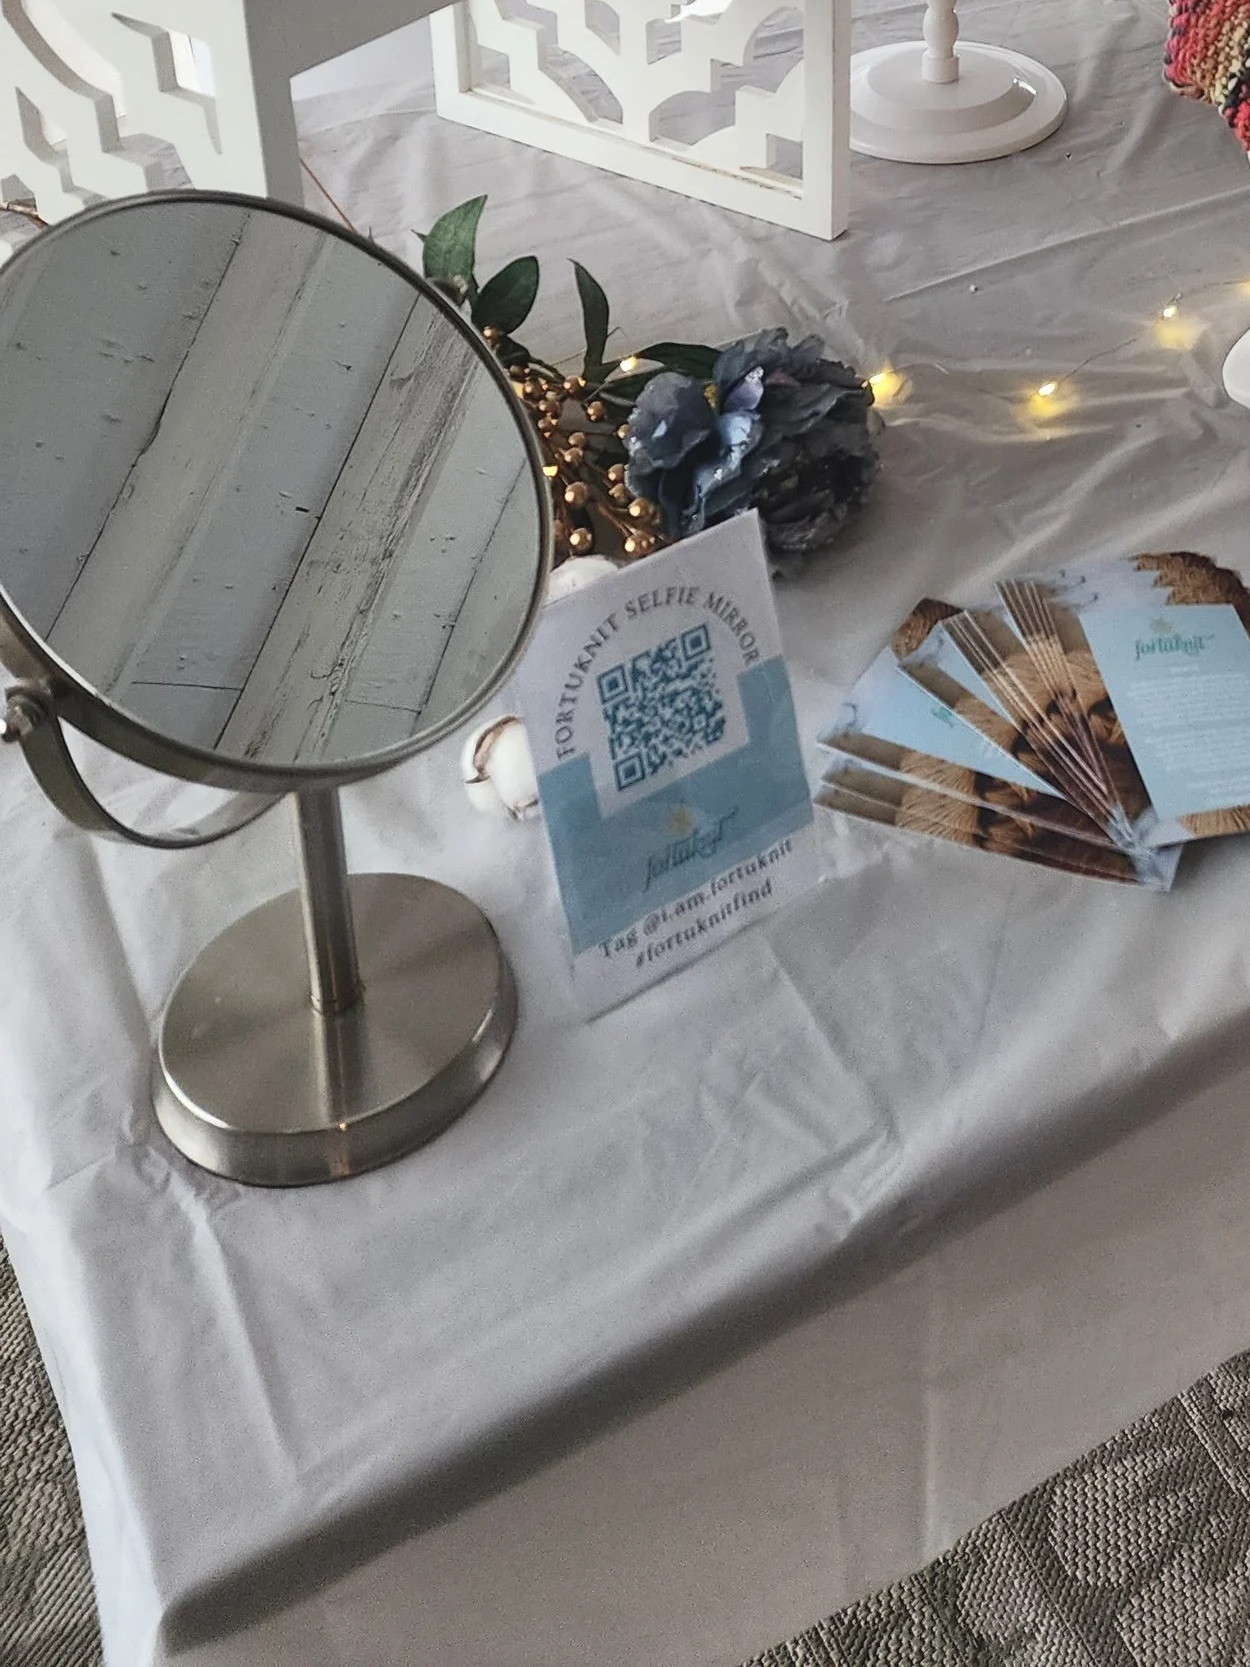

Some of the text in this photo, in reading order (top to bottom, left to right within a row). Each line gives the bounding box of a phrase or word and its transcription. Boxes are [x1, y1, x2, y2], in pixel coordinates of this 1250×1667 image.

[554, 586, 759, 760] FORTUKNIT SELFIE MIRROR
[600, 837, 793, 959] Tag @i.am.fortuknit
[636, 878, 773, 968] #fortuknitfind
